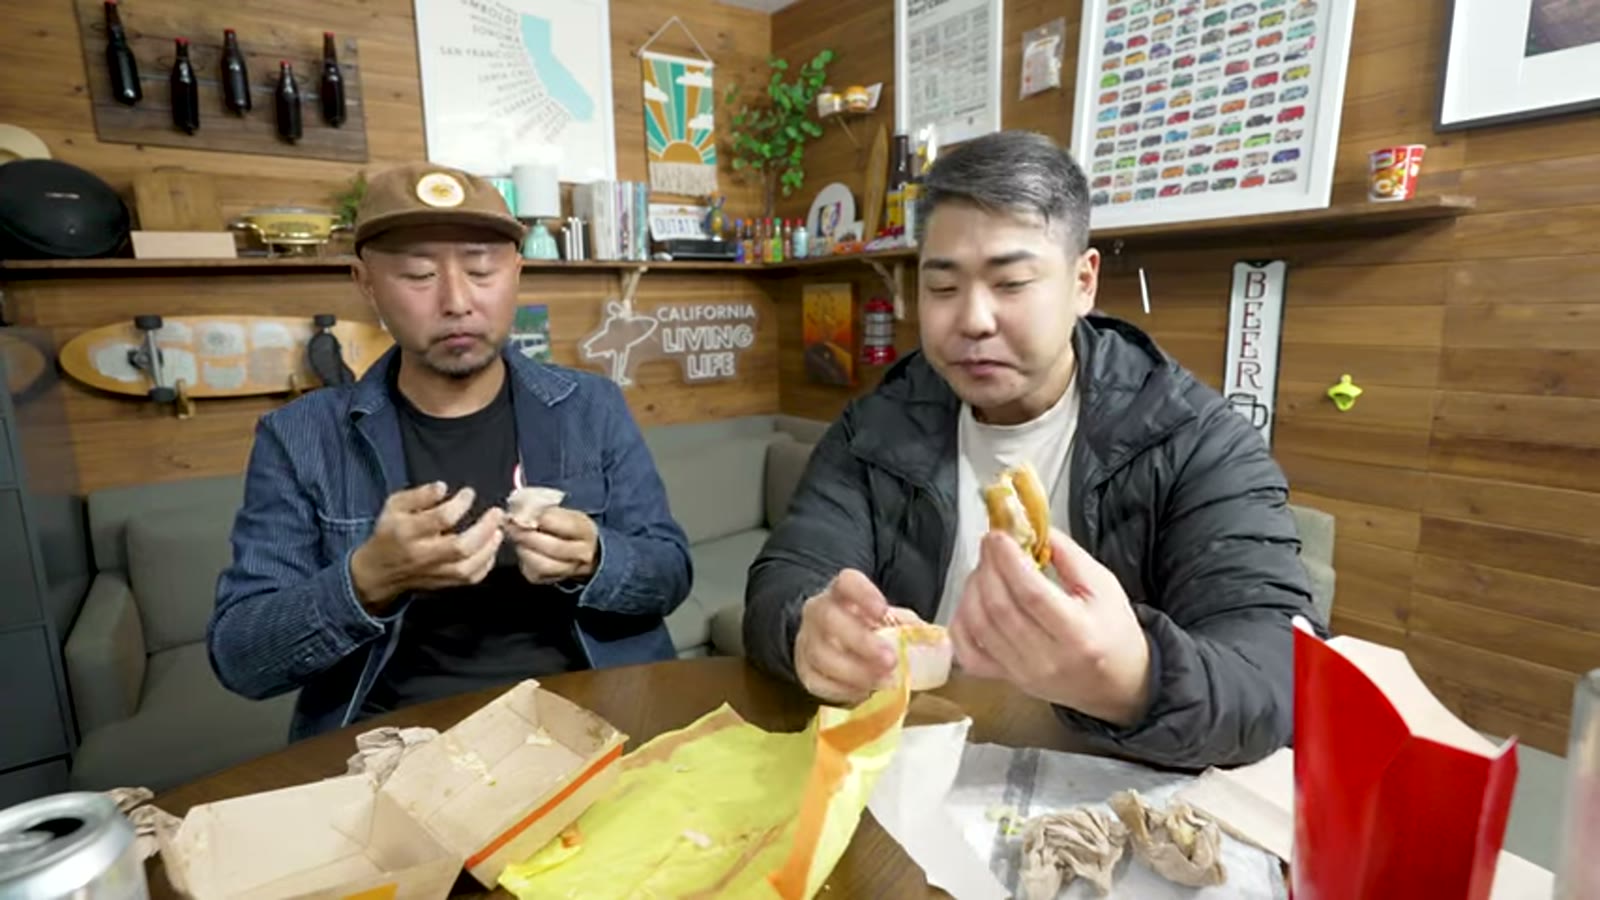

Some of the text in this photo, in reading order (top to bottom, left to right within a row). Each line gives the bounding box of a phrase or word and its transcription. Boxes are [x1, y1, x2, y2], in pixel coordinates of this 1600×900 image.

[657, 304, 756, 321] CALIFORNIA
[662, 324, 754, 352] LIVING
[1235, 271, 1267, 390] BEER
[687, 352, 736, 379] LIFE
